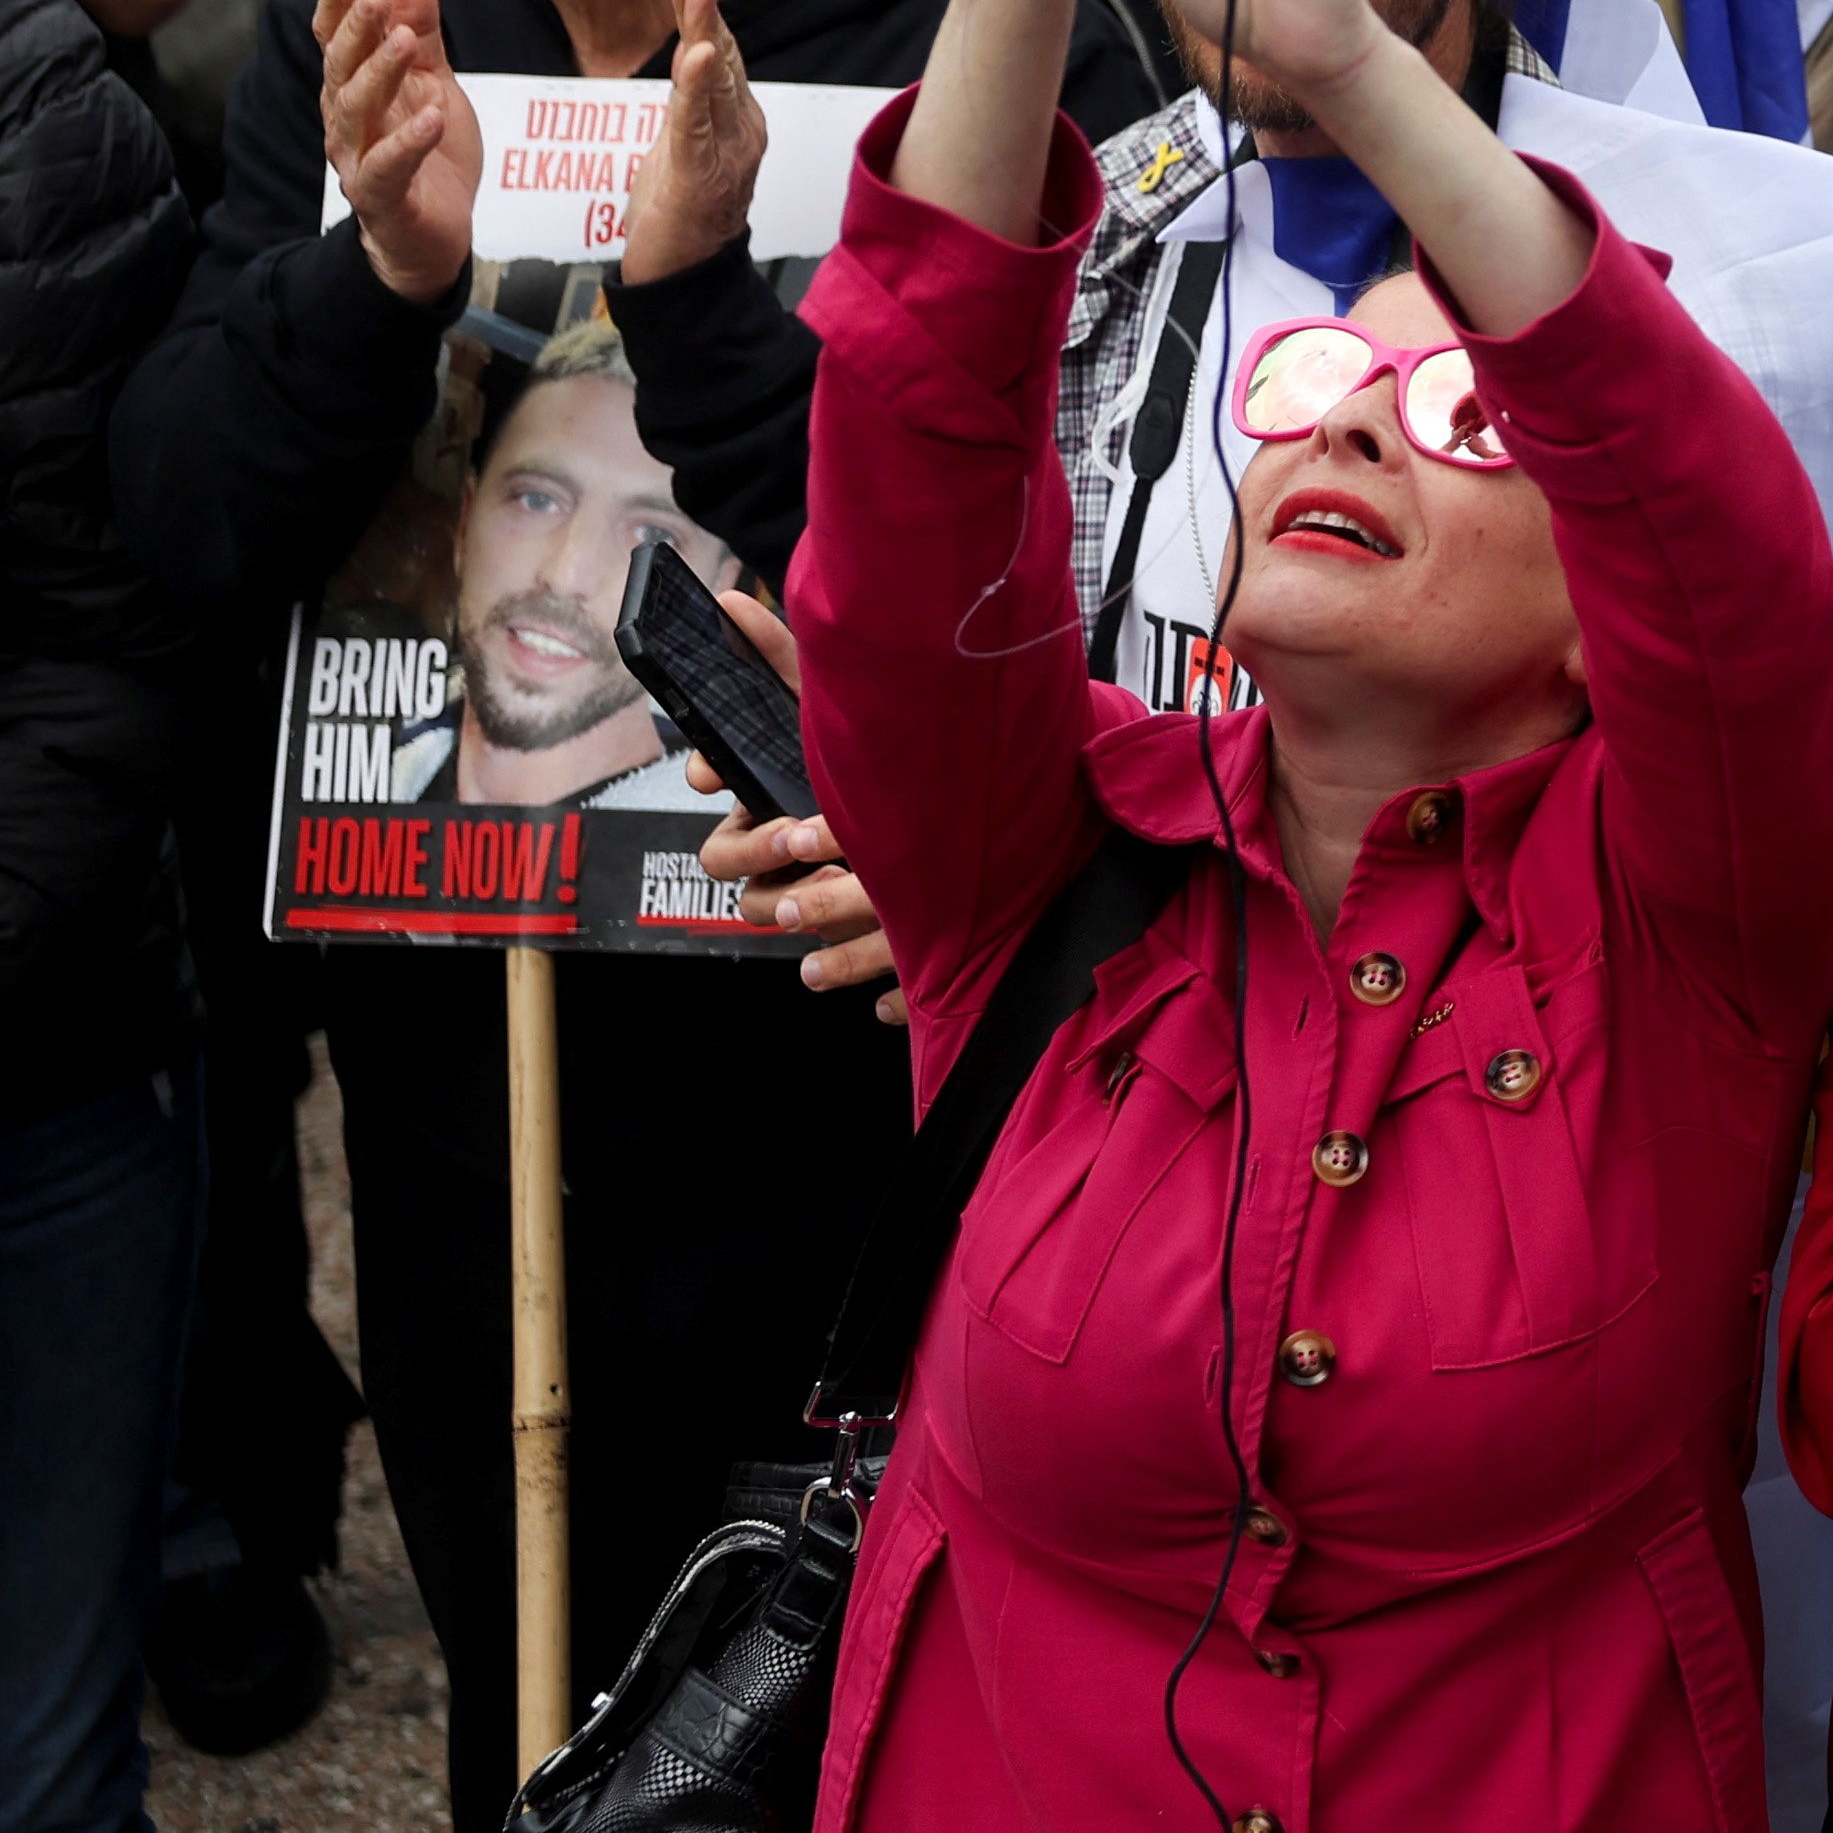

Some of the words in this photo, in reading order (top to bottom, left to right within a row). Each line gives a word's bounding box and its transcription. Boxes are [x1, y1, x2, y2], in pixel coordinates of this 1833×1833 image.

[525, 98, 629, 144] בוחבוט
[500, 148, 614, 194] ELKANA
[307, 635, 448, 719] BRING
[301, 721, 392, 804] HIM
[294, 816, 432, 898] HOME
[442, 812, 581, 905] NOW!
